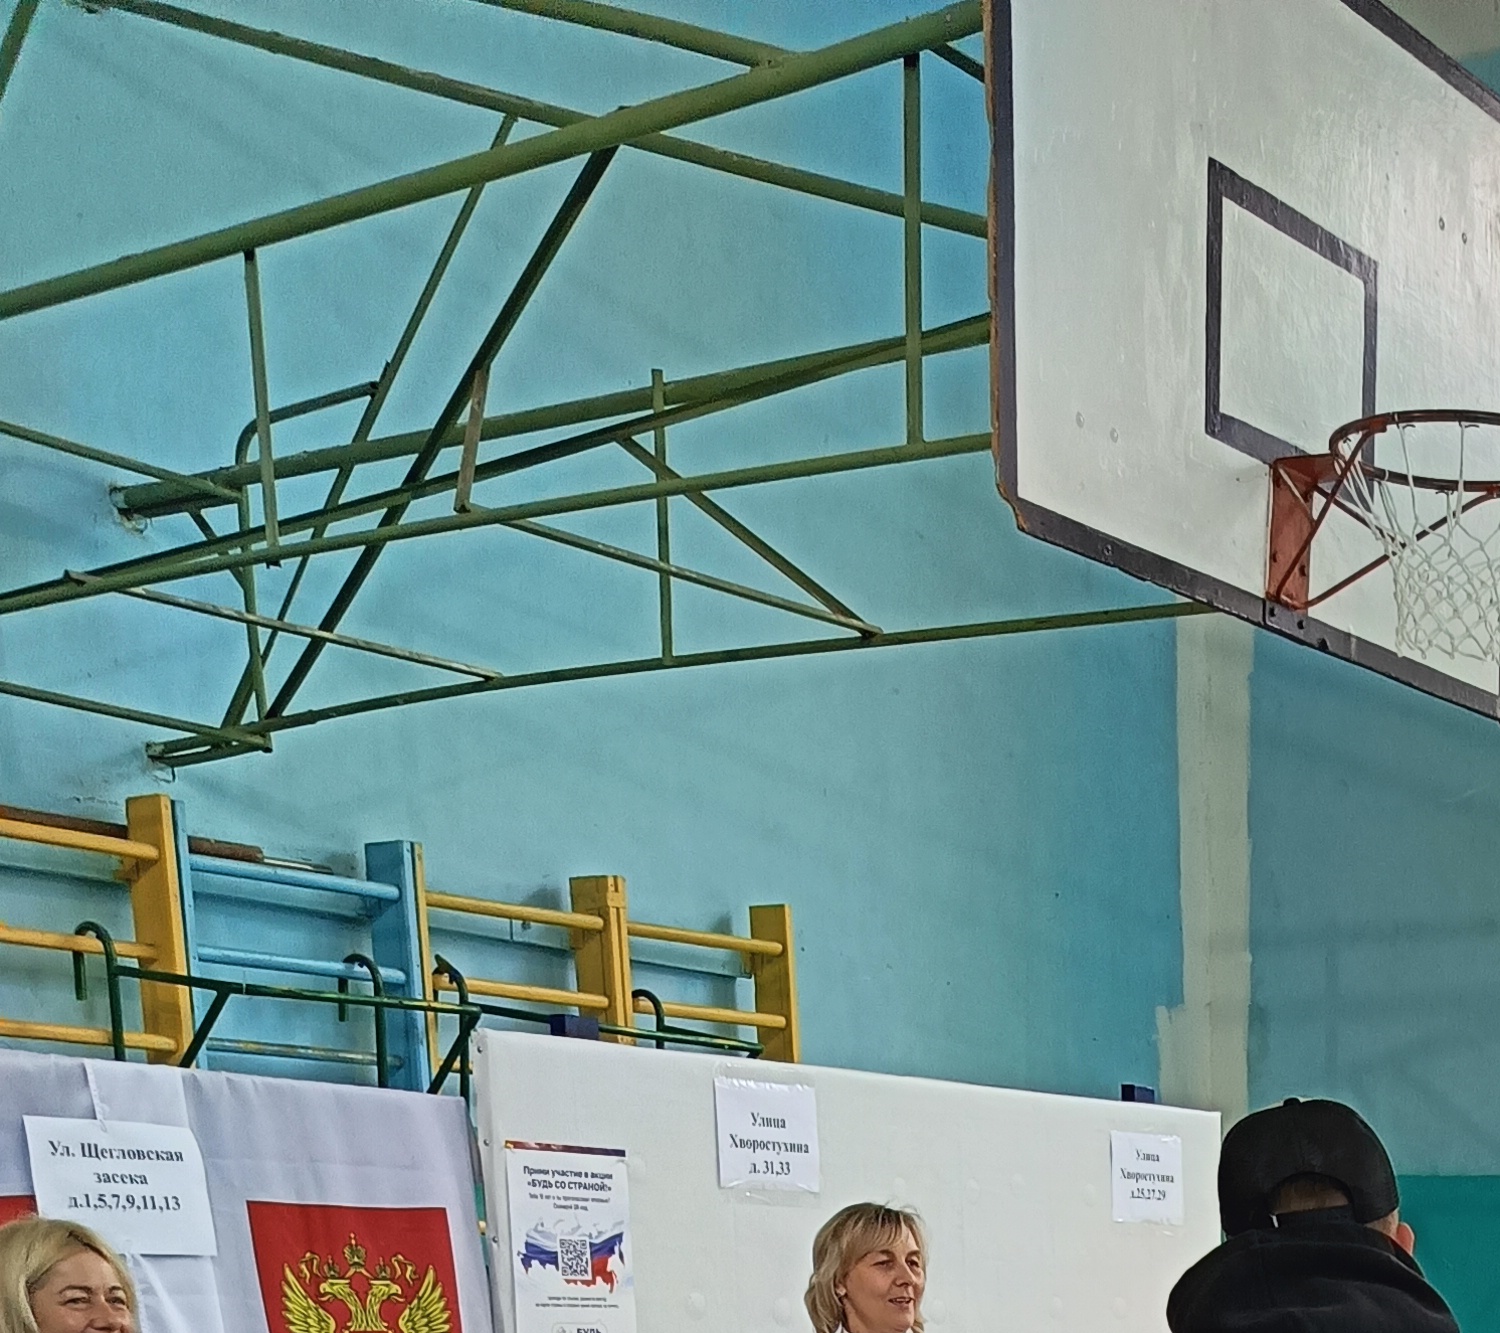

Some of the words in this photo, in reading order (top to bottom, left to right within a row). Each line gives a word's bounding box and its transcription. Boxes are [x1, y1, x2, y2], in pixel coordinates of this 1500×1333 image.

[750, 1111, 787, 1129] Улица
[48, 1140, 75, 1158] Ул.
[81, 1141, 184, 1162] Щегловская
[729, 1133, 810, 1156] Хворостухина
[762, 1160, 791, 1177] 31,33
[93, 1172, 149, 1186] засека
[554, 1180, 566, 1189] СО
[68, 1193, 181, 1213] д.1,5,7,9,11,13
